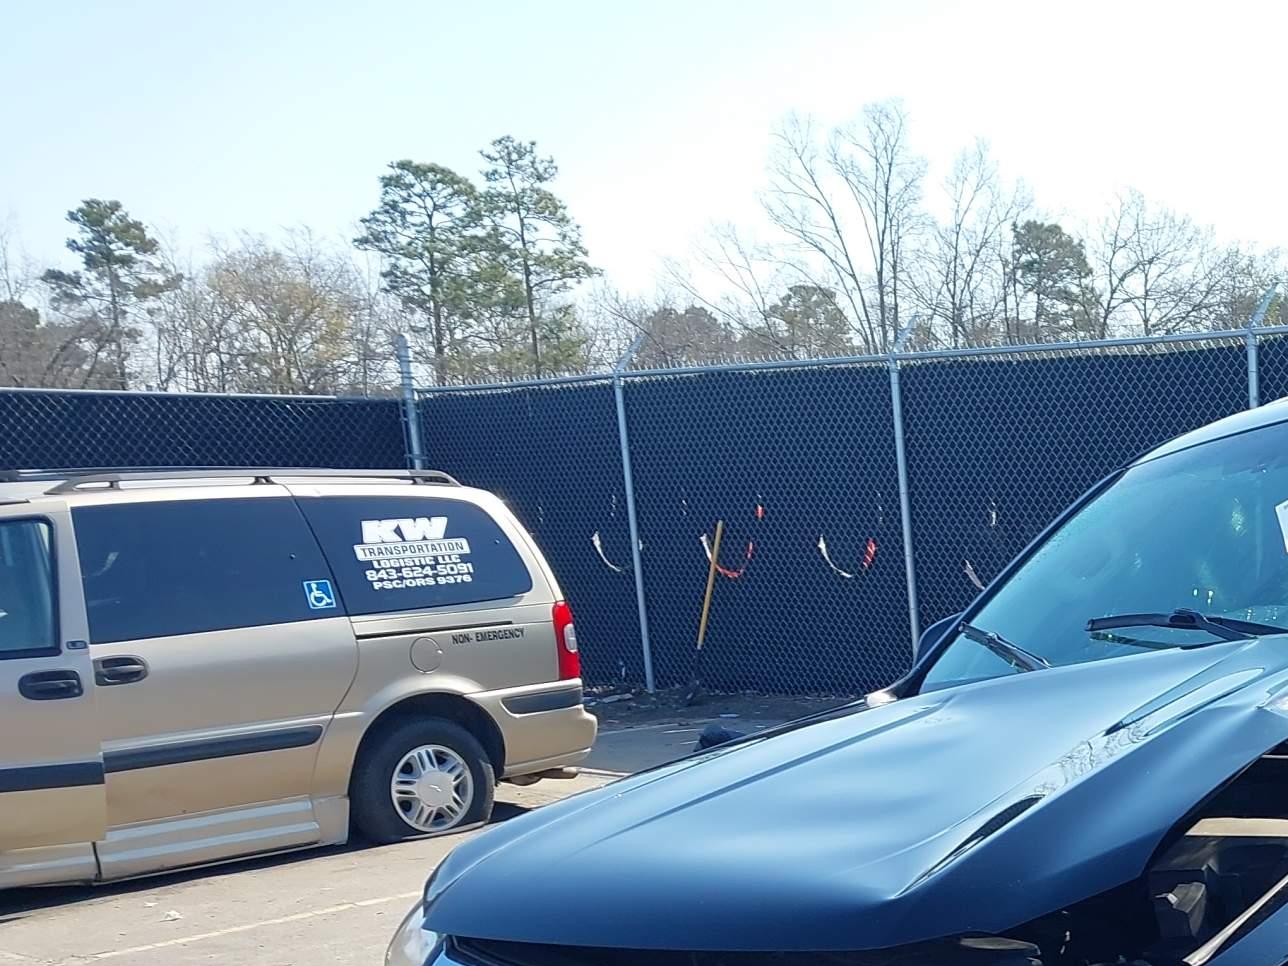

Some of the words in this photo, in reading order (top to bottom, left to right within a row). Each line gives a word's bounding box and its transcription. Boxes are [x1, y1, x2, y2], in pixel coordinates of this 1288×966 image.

[361, 516, 448, 543] KW
[360, 541, 465, 558] TRANSPORTATION
[373, 557, 434, 568] LOGISTIC
[438, 554, 462, 564] LLC
[365, 563, 474, 581] 843-624-5091
[373, 577, 435, 590] PSC/ORS
[437, 574, 473, 585] 9376
[452, 632, 473, 645] NON-
[475, 628, 525, 642] EMERGENCY
